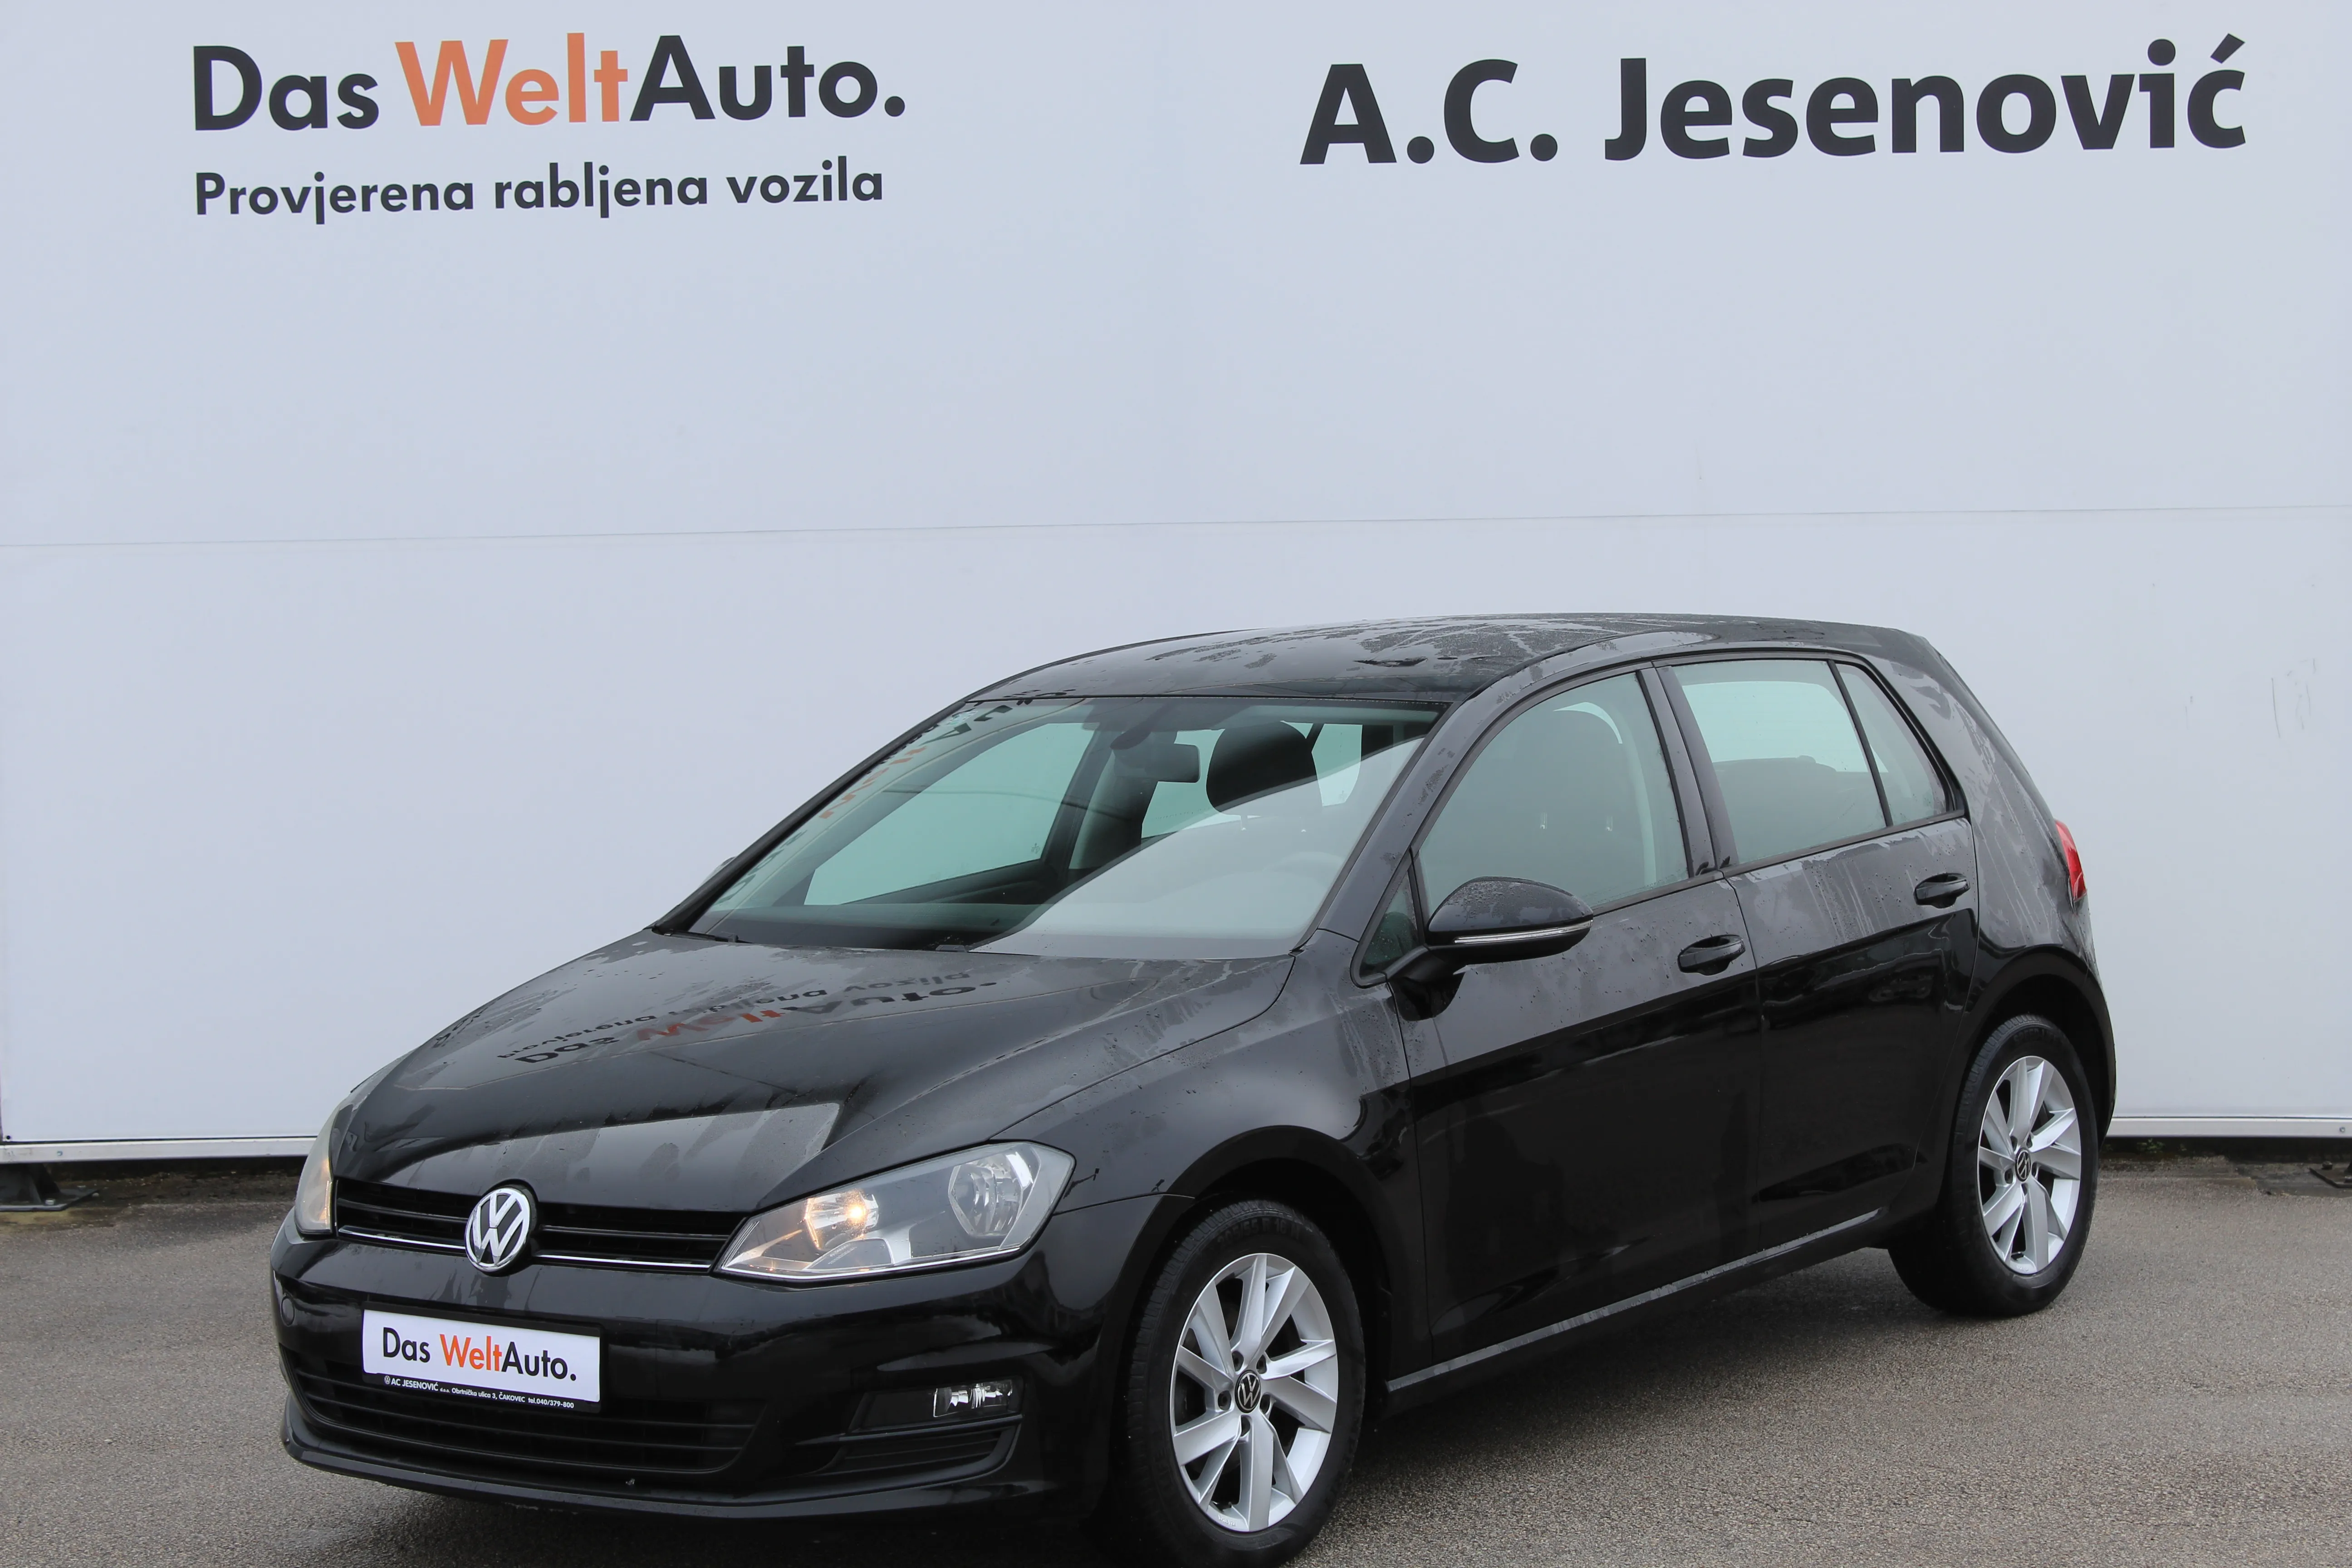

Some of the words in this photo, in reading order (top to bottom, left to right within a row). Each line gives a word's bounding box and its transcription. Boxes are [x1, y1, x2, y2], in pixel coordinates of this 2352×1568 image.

[193, 46, 379, 131] Das
[395, 33, 905, 126] WeltAuto.
[1300, 59, 1558, 164] A.C.
[1605, 34, 2245, 161] Jesenović
[196, 172, 473, 225] Provjerena
[495, 162, 707, 218] rabljena
[726, 156, 882, 203] vozila
[383, 1327, 431, 1363] Das
[440, 1334, 577, 1382] WeltAuto.
[402, 1379, 439, 1391] JESENOVIĆ
[451, 1387, 477, 1396] Obrtnička
[499, 1392, 525, 1402] ČAKOVEC
[528, 1397, 574, 1408] tel.040/379-800
